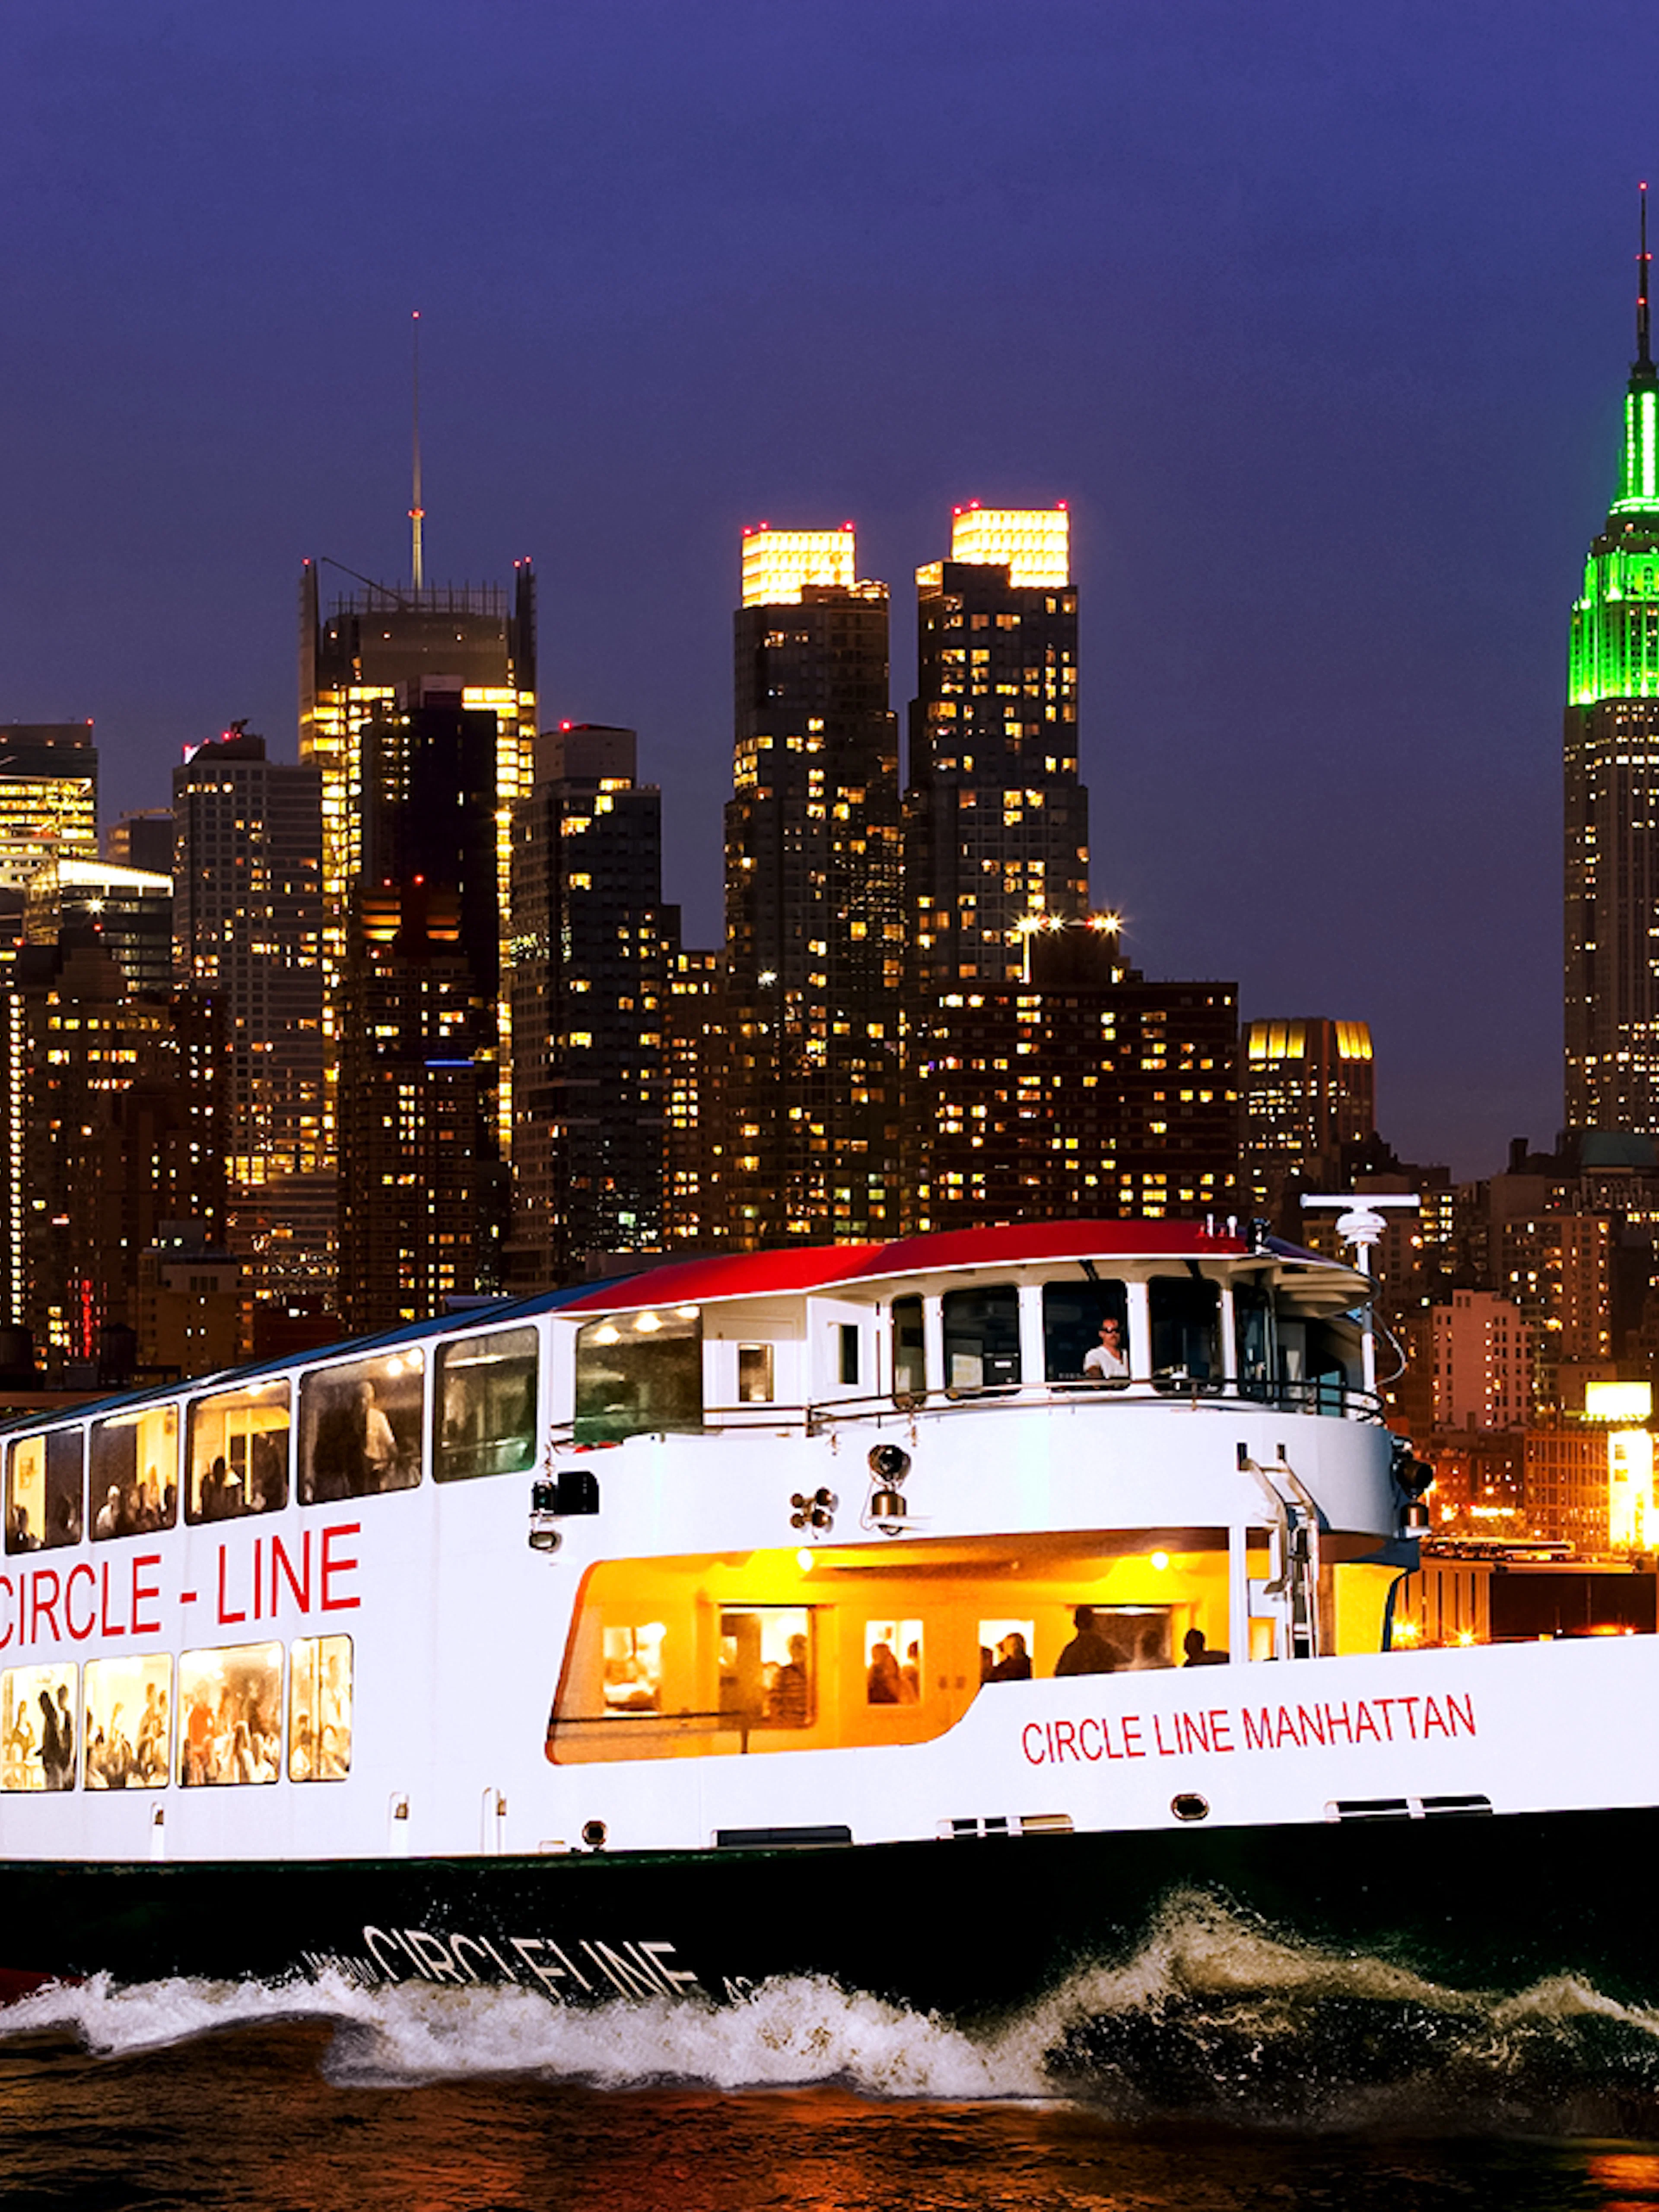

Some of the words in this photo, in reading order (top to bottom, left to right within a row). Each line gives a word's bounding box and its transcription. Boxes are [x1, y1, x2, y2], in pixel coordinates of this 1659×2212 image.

[218, 1522, 361, 1625] LINE
[1022, 1716, 1145, 1765] CIRCLE
[1154, 1709, 1234, 1756] LINE
[1241, 1694, 1476, 1748] MANHATTAN
